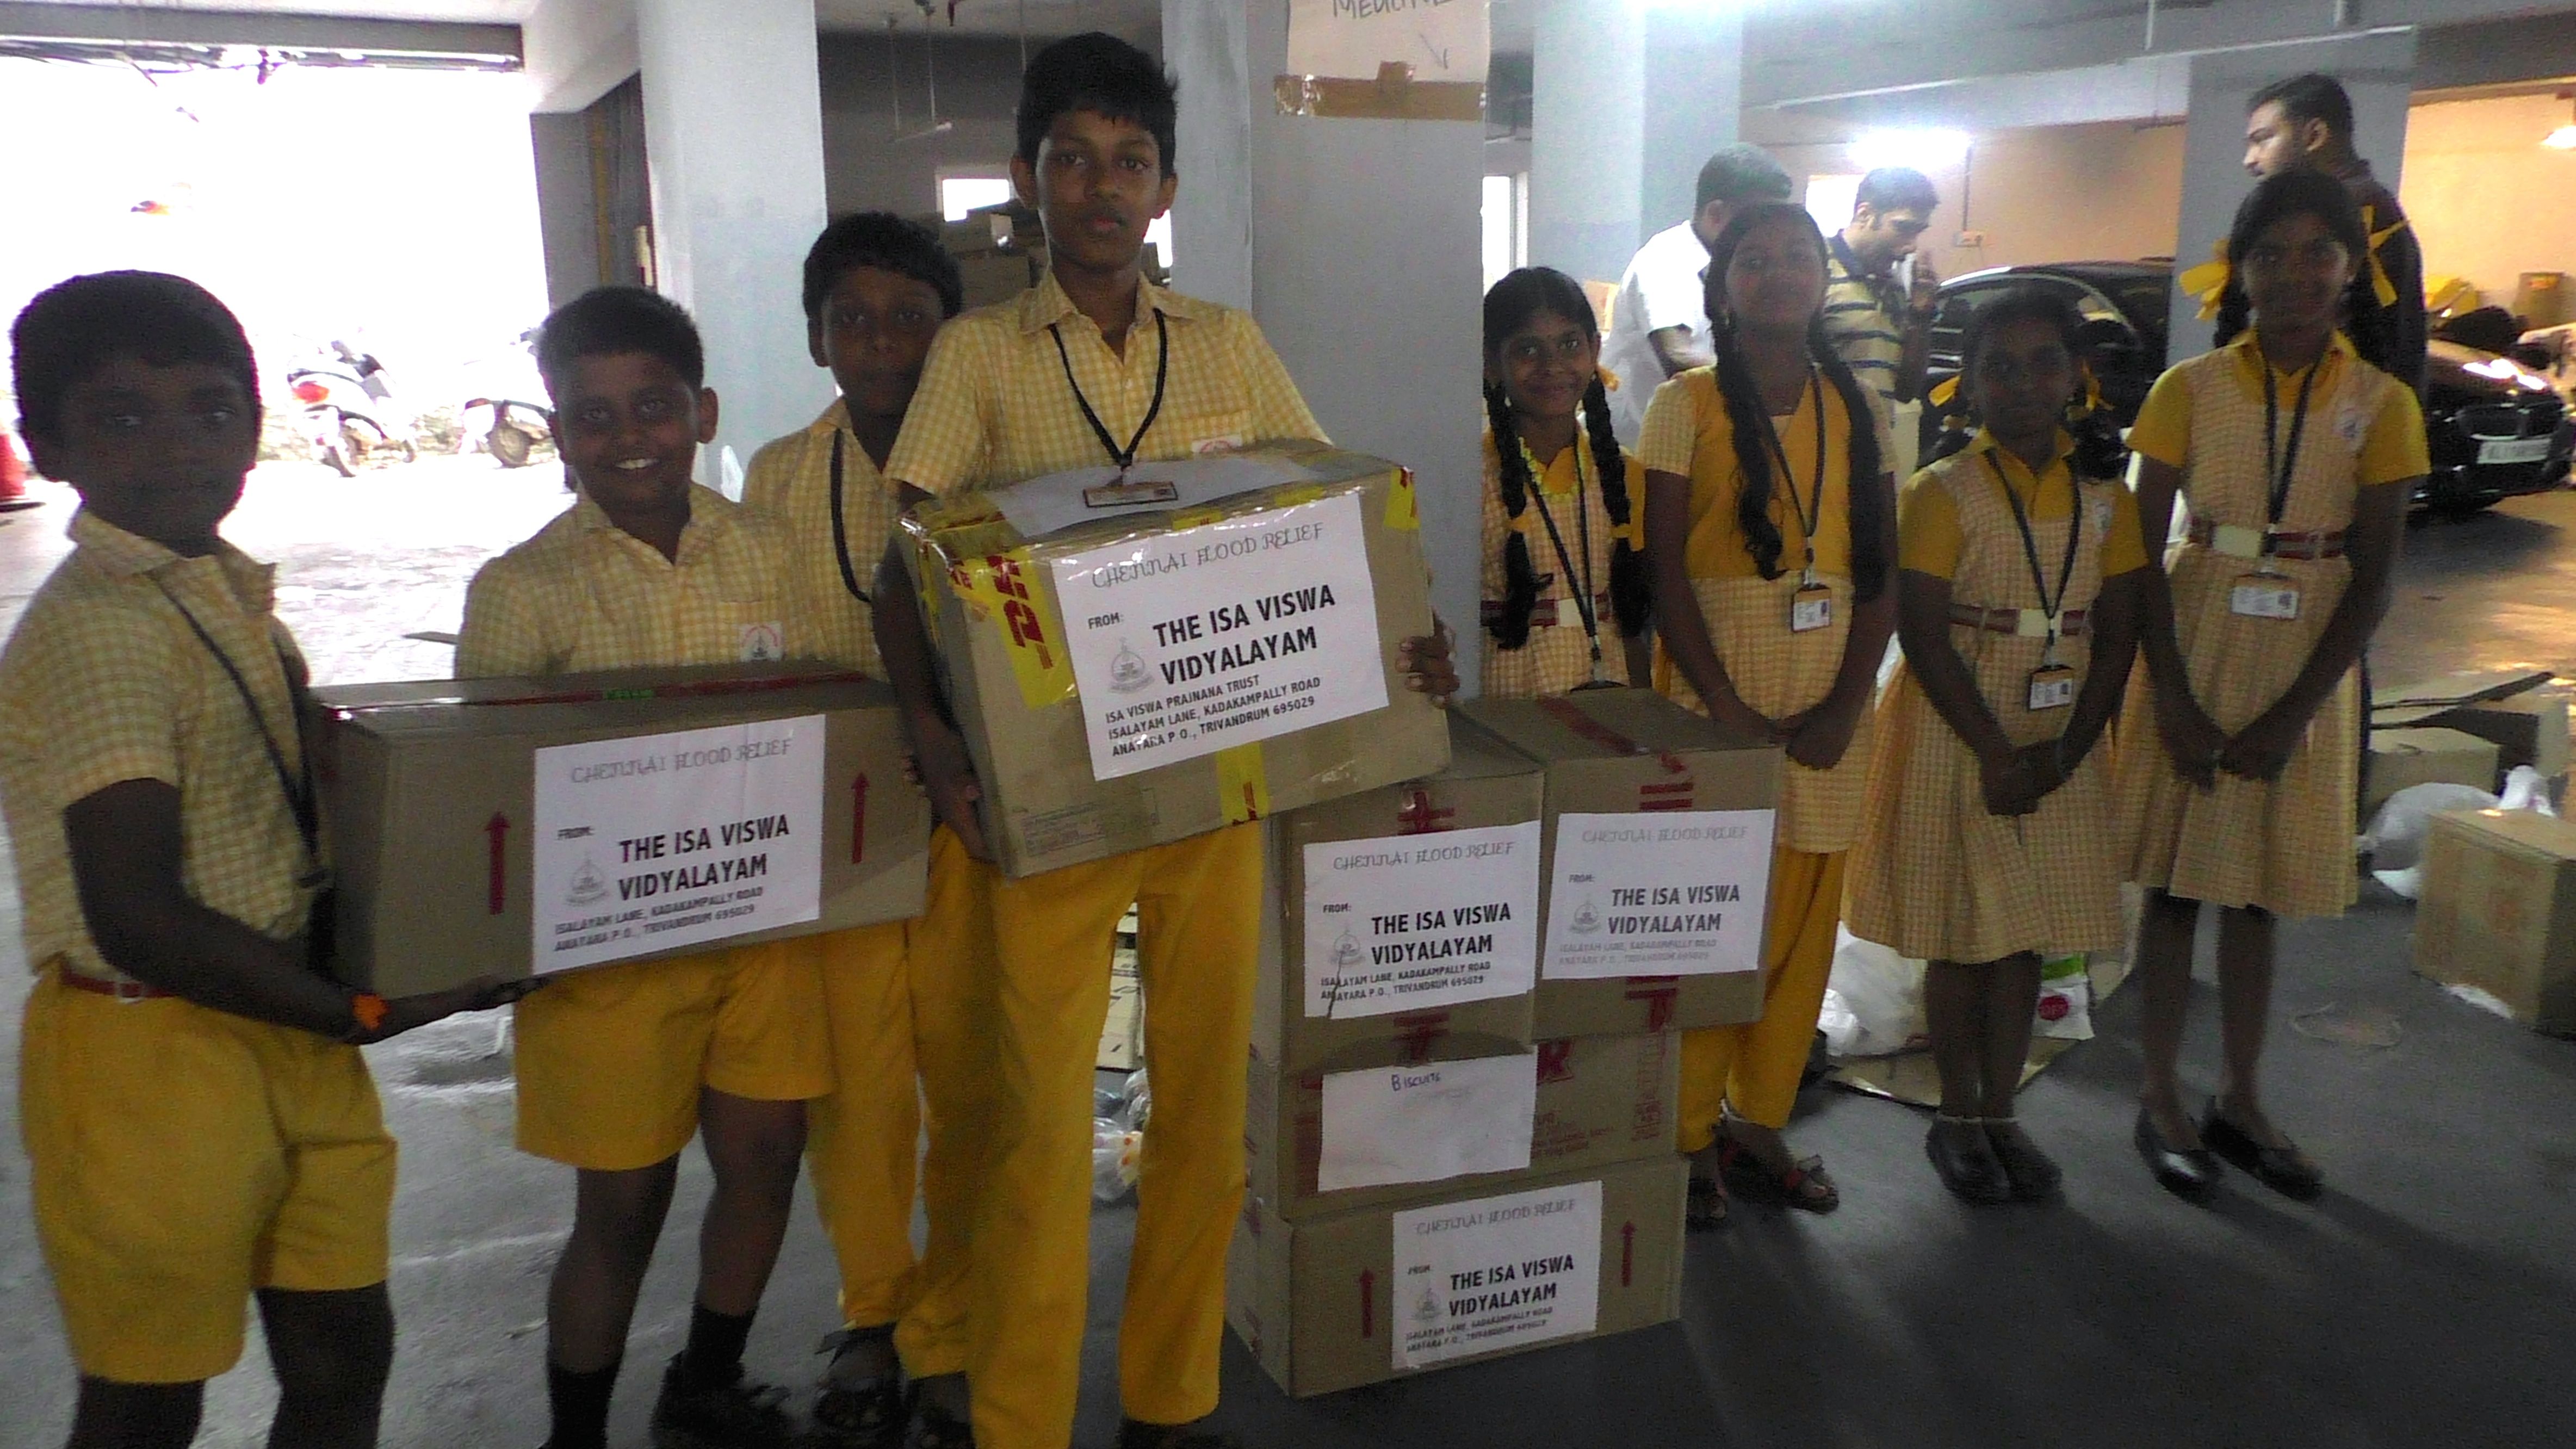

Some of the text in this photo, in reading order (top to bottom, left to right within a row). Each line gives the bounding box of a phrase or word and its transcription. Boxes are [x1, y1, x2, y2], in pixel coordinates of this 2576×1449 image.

[1333, 0, 1452, 18] MEDIC
[1092, 522, 1324, 589] CHENNAI FLOOD RELIEF
[986, 555, 1045, 647] DH
[1153, 584, 1335, 648] THE ISA VISWA
[1088, 613, 1124, 629] FROM:
[1160, 626, 1317, 685] VIDYALAYAM
[1105, 675, 1260, 724] ISA VISWA PRAJNANA TRUST
[1108, 717, 1165, 740] ISALAYAM
[1203, 685, 1287, 716] KADAKAMPALLY
[1291, 677, 1320, 693] ROAD
[1200, 708, 1270, 734] TRIVANDRUM
[1273, 696, 1315, 715] 695029
[736, 739, 792, 761] RELIEF
[620, 814, 789, 863] THE ISA VISWA
[1334, 842, 1515, 870] CHENNAI FLOOD RELIEF
[618, 853, 767, 900] VIDYALAYAM
[1323, 903, 1352, 913] FROM:
[1612, 885, 1740, 906] THE ISA VISWA
[1372, 903, 1511, 934] THE ISA VISWA
[1608, 914, 1721, 934] VIDYALAYAM
[1372, 935, 1492, 964] VIDYALAYAM
[1468, 961, 1490, 971] ROAD
[1451, 1254, 1574, 1290] THE ISA VISWA
[1449, 1283, 1557, 1317] VIDYALAYAM
